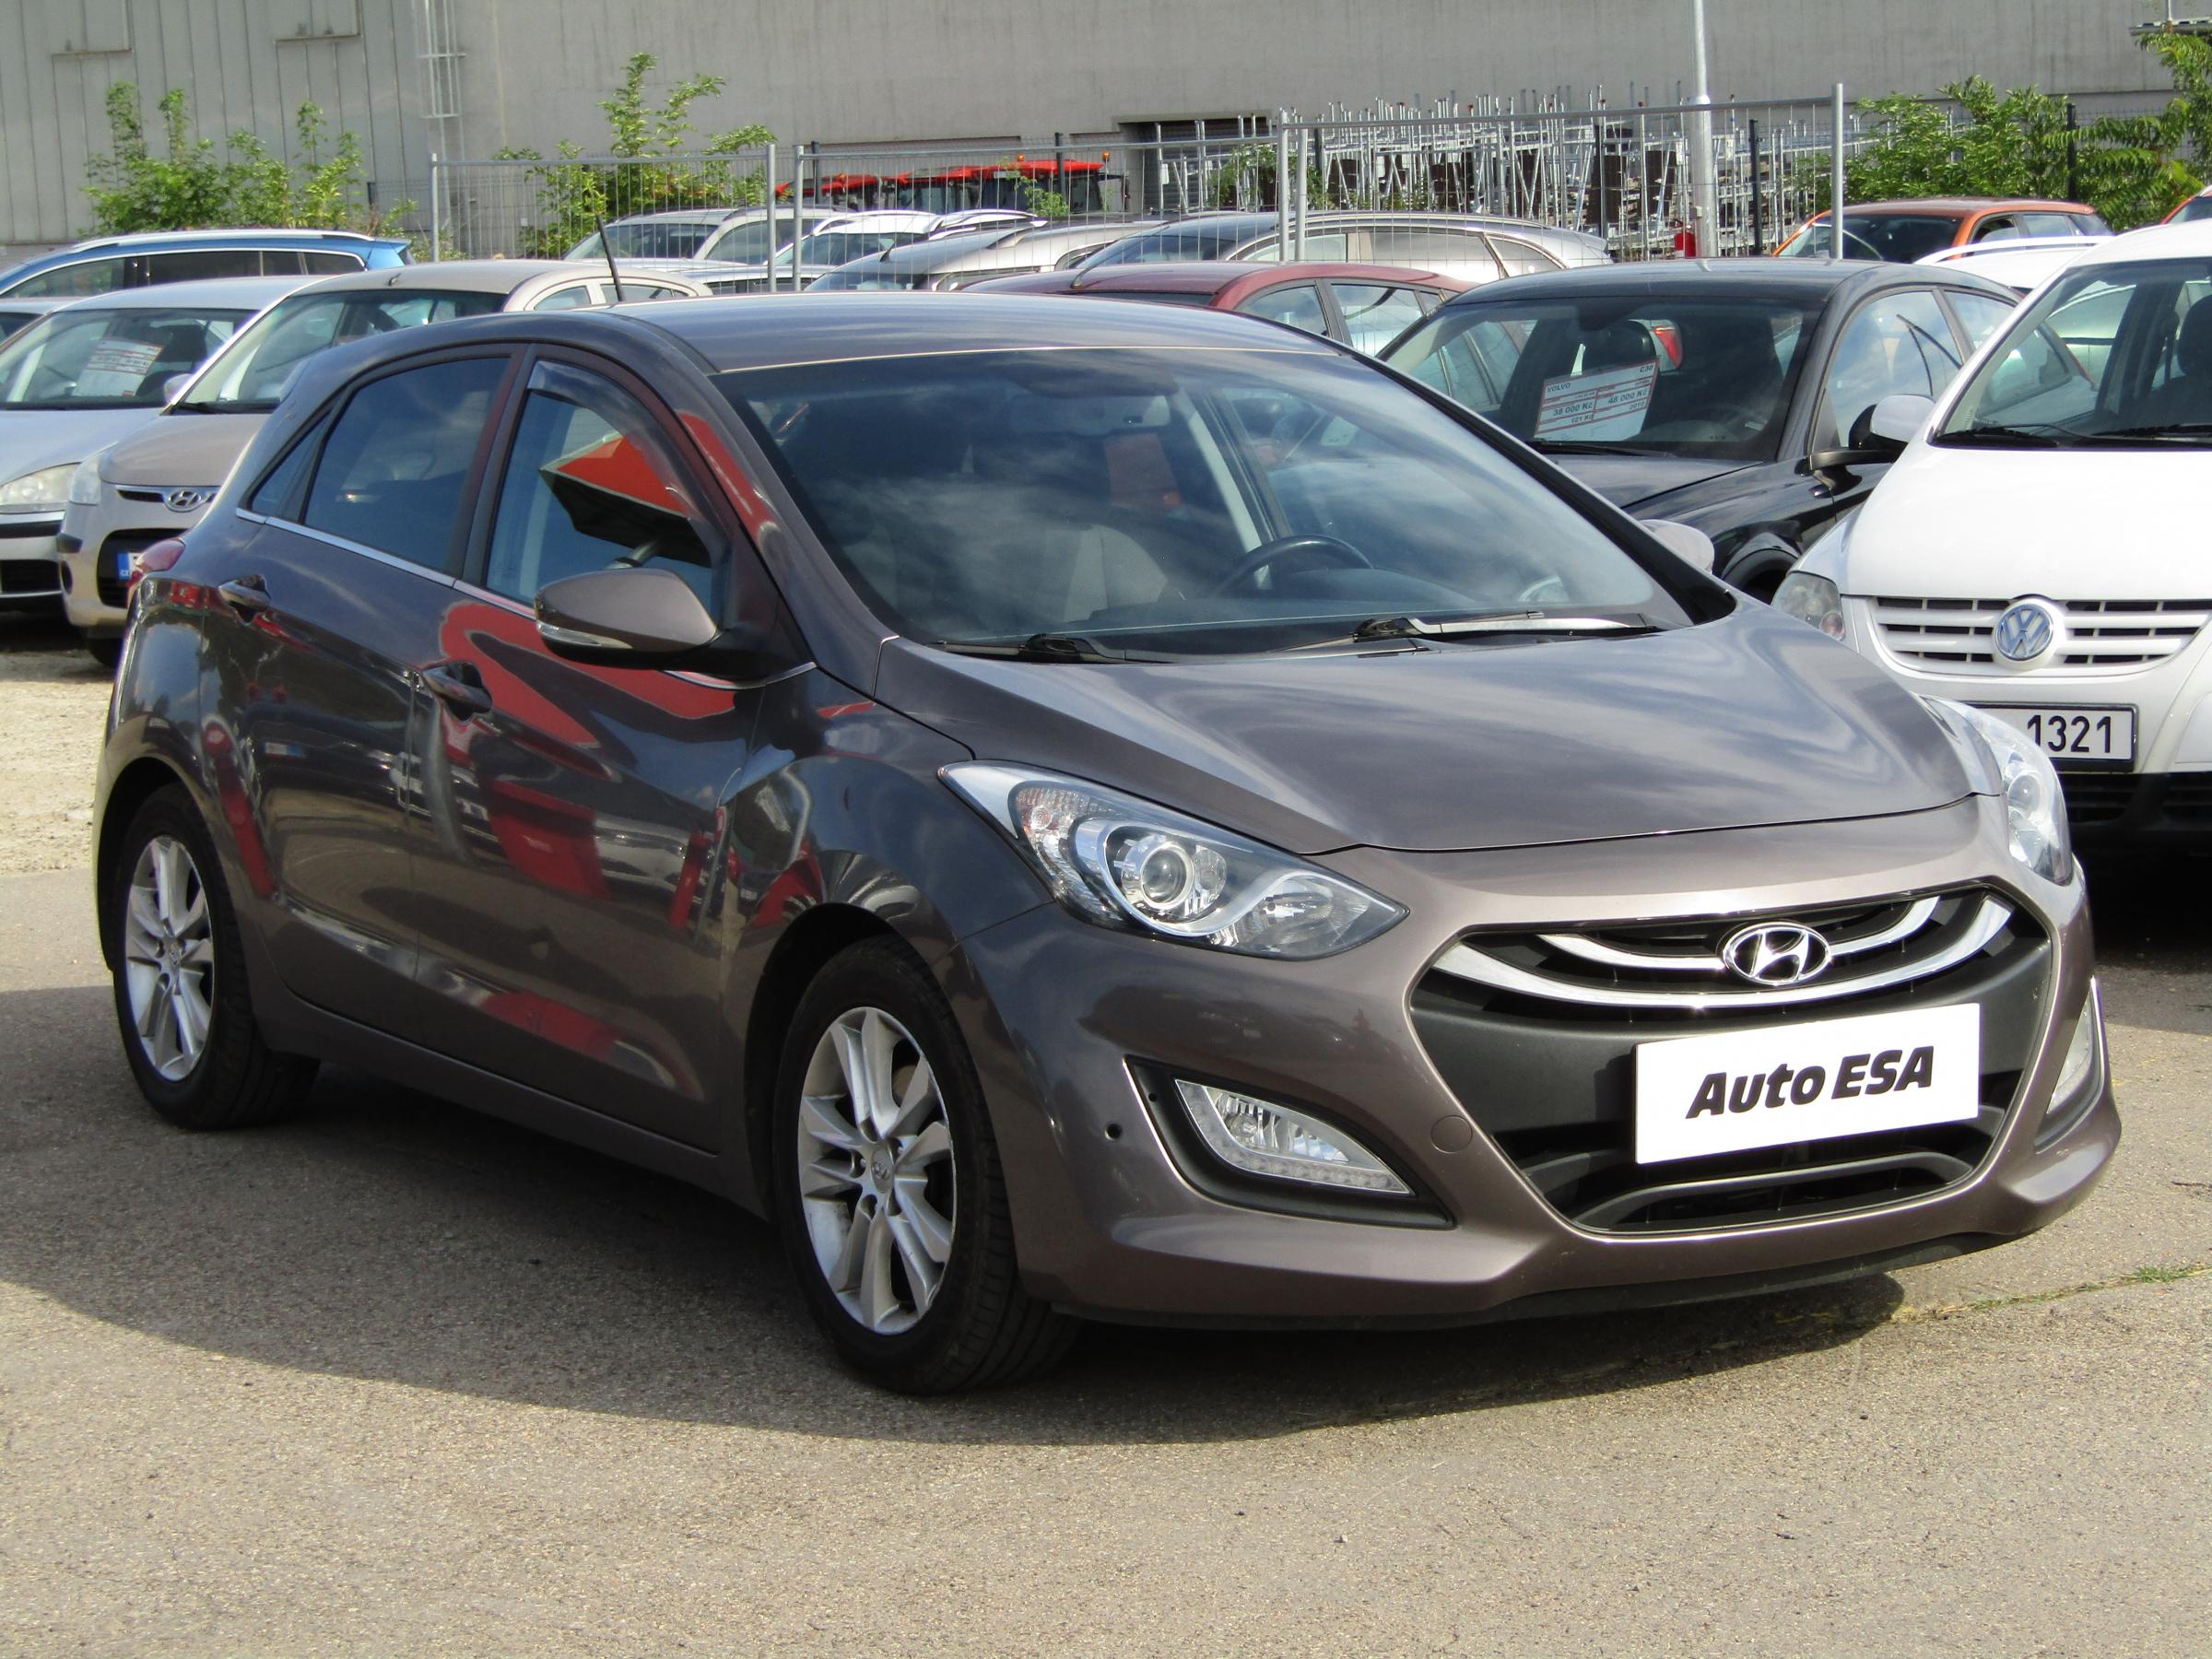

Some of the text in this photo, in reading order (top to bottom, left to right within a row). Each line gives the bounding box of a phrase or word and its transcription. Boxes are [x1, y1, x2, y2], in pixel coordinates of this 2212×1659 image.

[1547, 382, 1571, 393] VOLVO
[1620, 392, 1635, 401] 000
[1565, 404, 1580, 413] 000
[2028, 714, 2112, 753] 1321
[1685, 1045, 1935, 1119] Auto ESA
